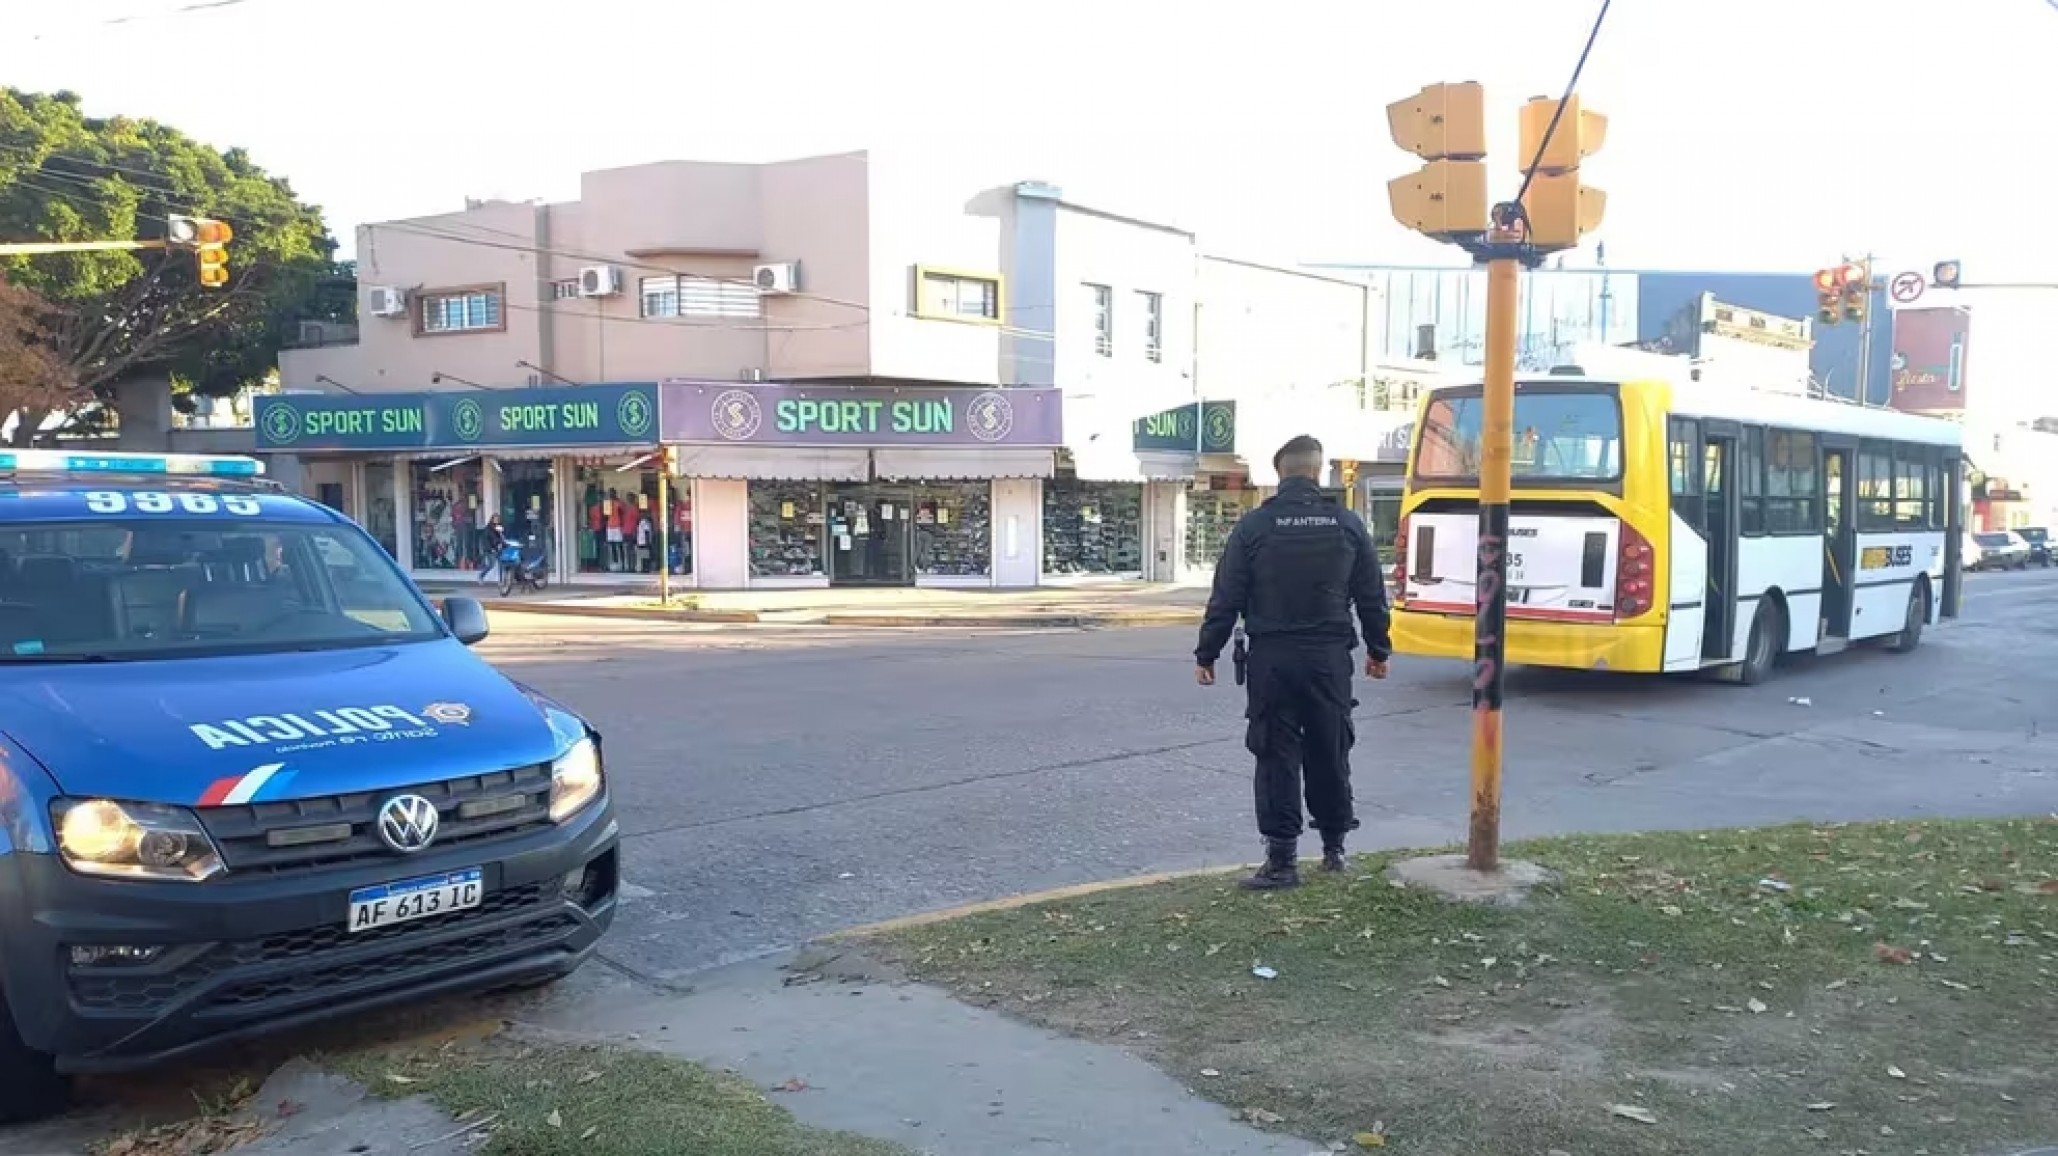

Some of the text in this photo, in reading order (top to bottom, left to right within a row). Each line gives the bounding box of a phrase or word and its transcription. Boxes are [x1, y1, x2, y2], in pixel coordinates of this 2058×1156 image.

[306, 408, 423, 435] SPORT SUN
[501, 402, 599, 431] SPORT SUN
[777, 400, 880, 433] SPORT
[891, 398, 953, 433] SUN
[1146, 412, 1177, 437] SUN
[84, 490, 261, 516] 9965
[1275, 516, 1339, 527] INFANTERIA
[356, 882, 476, 927] AF 613 IC
